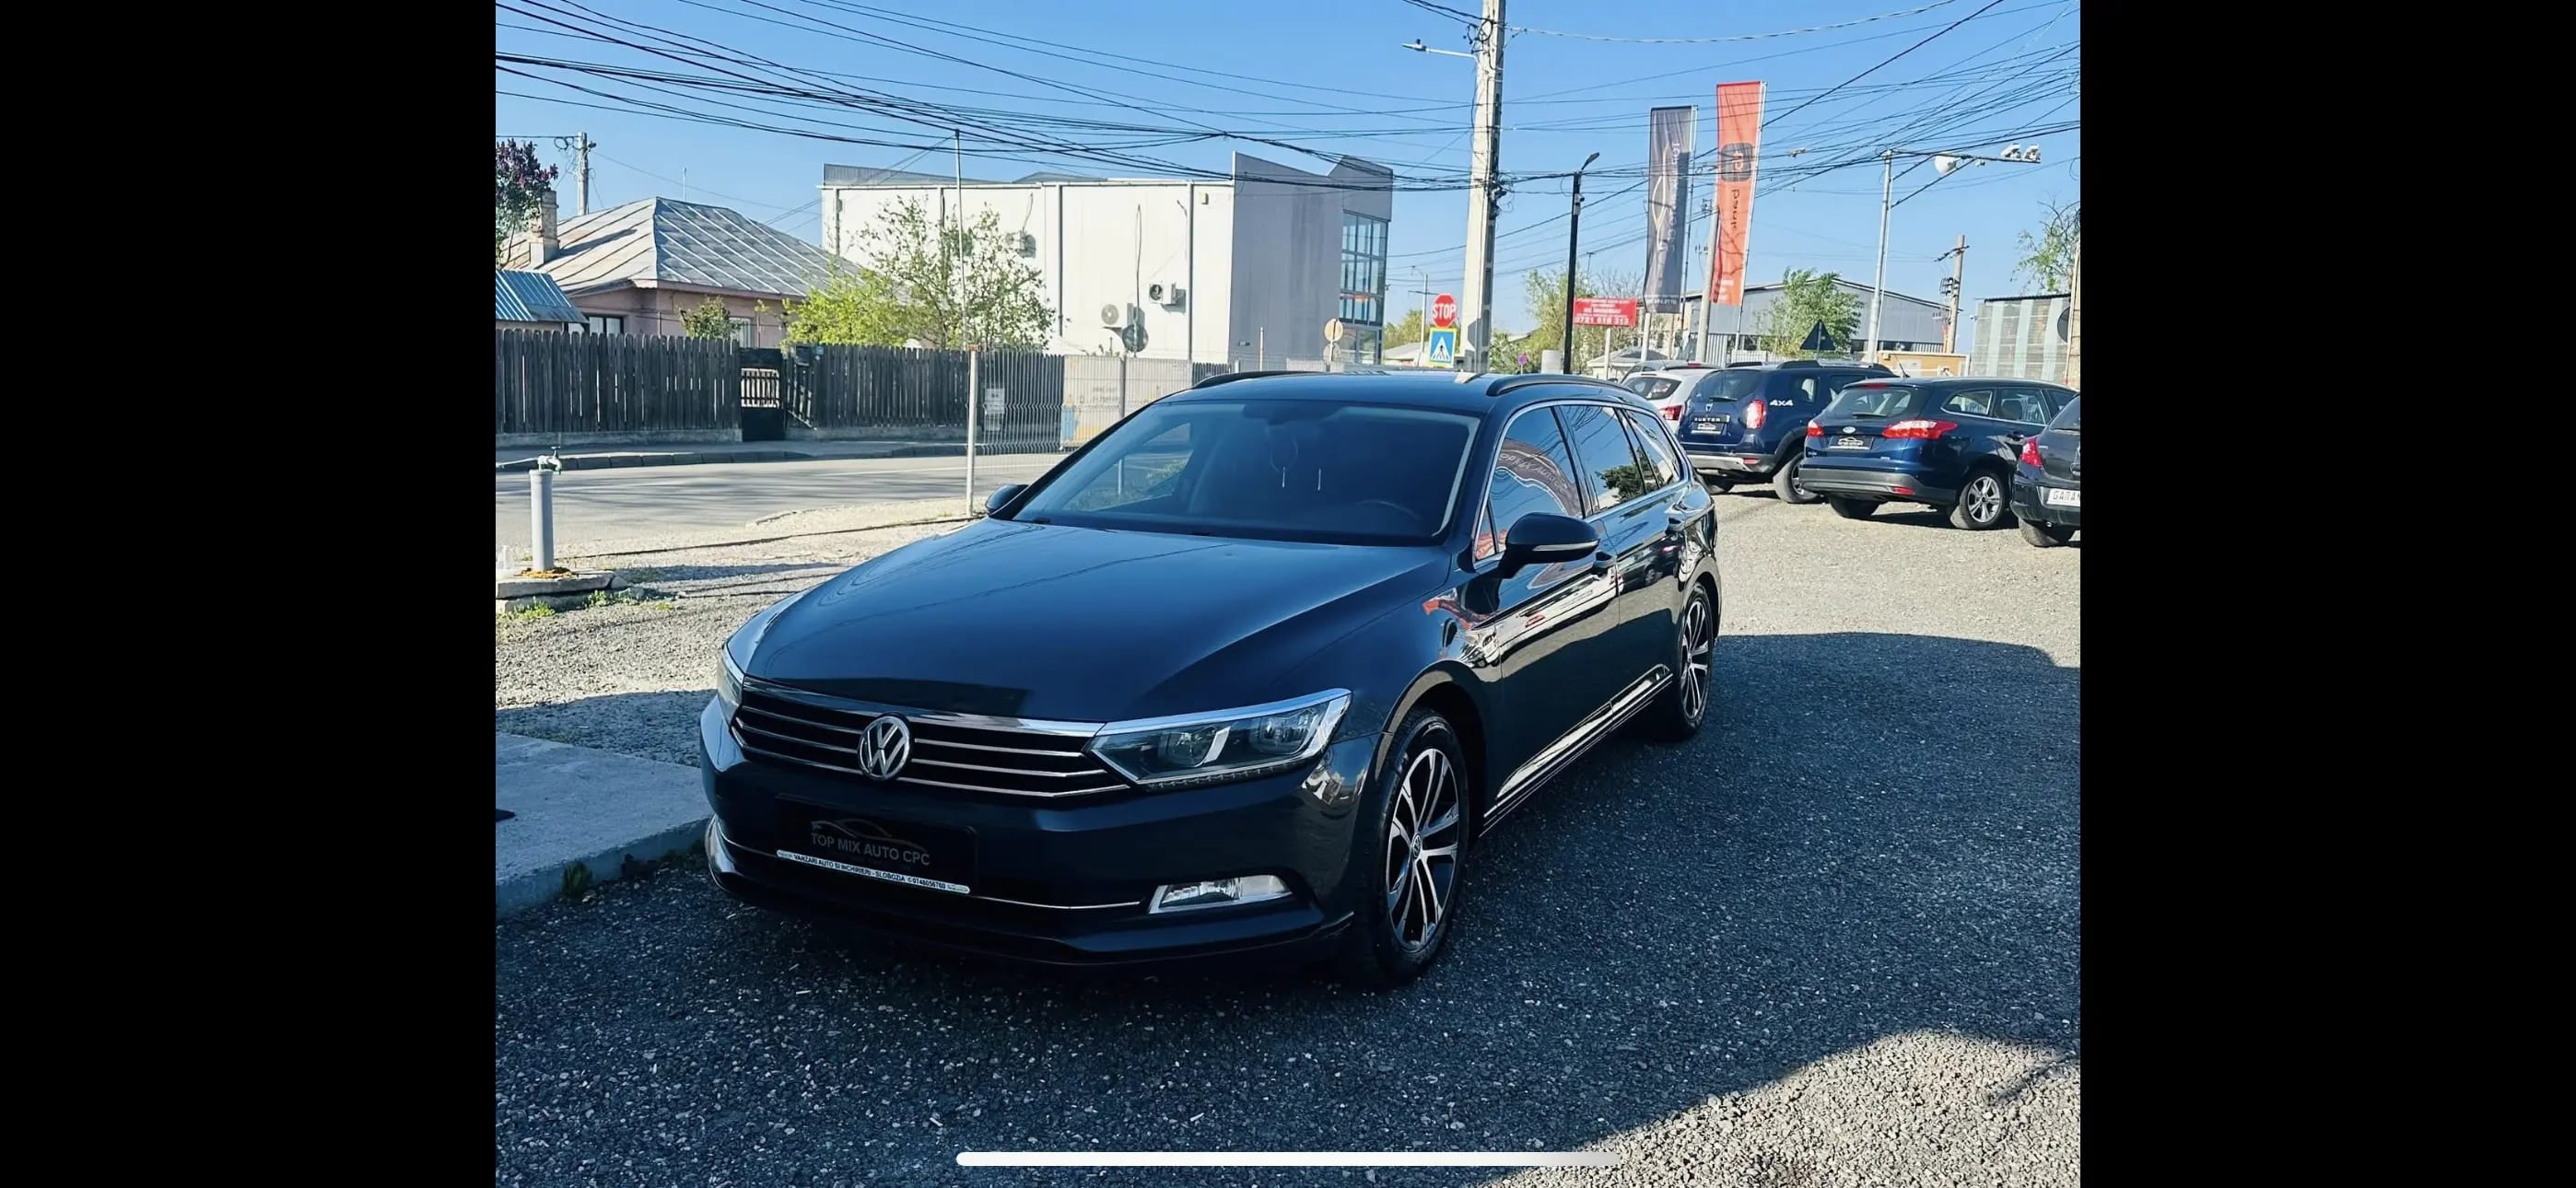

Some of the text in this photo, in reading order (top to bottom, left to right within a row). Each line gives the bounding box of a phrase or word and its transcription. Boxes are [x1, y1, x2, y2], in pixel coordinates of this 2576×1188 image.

[1433, 303, 1456, 320] STOP
[811, 833, 931, 866] TOP MIX AUTO CPC
[818, 858, 834, 868] AUTO
[875, 870, 906, 882] SLOBOZIA
